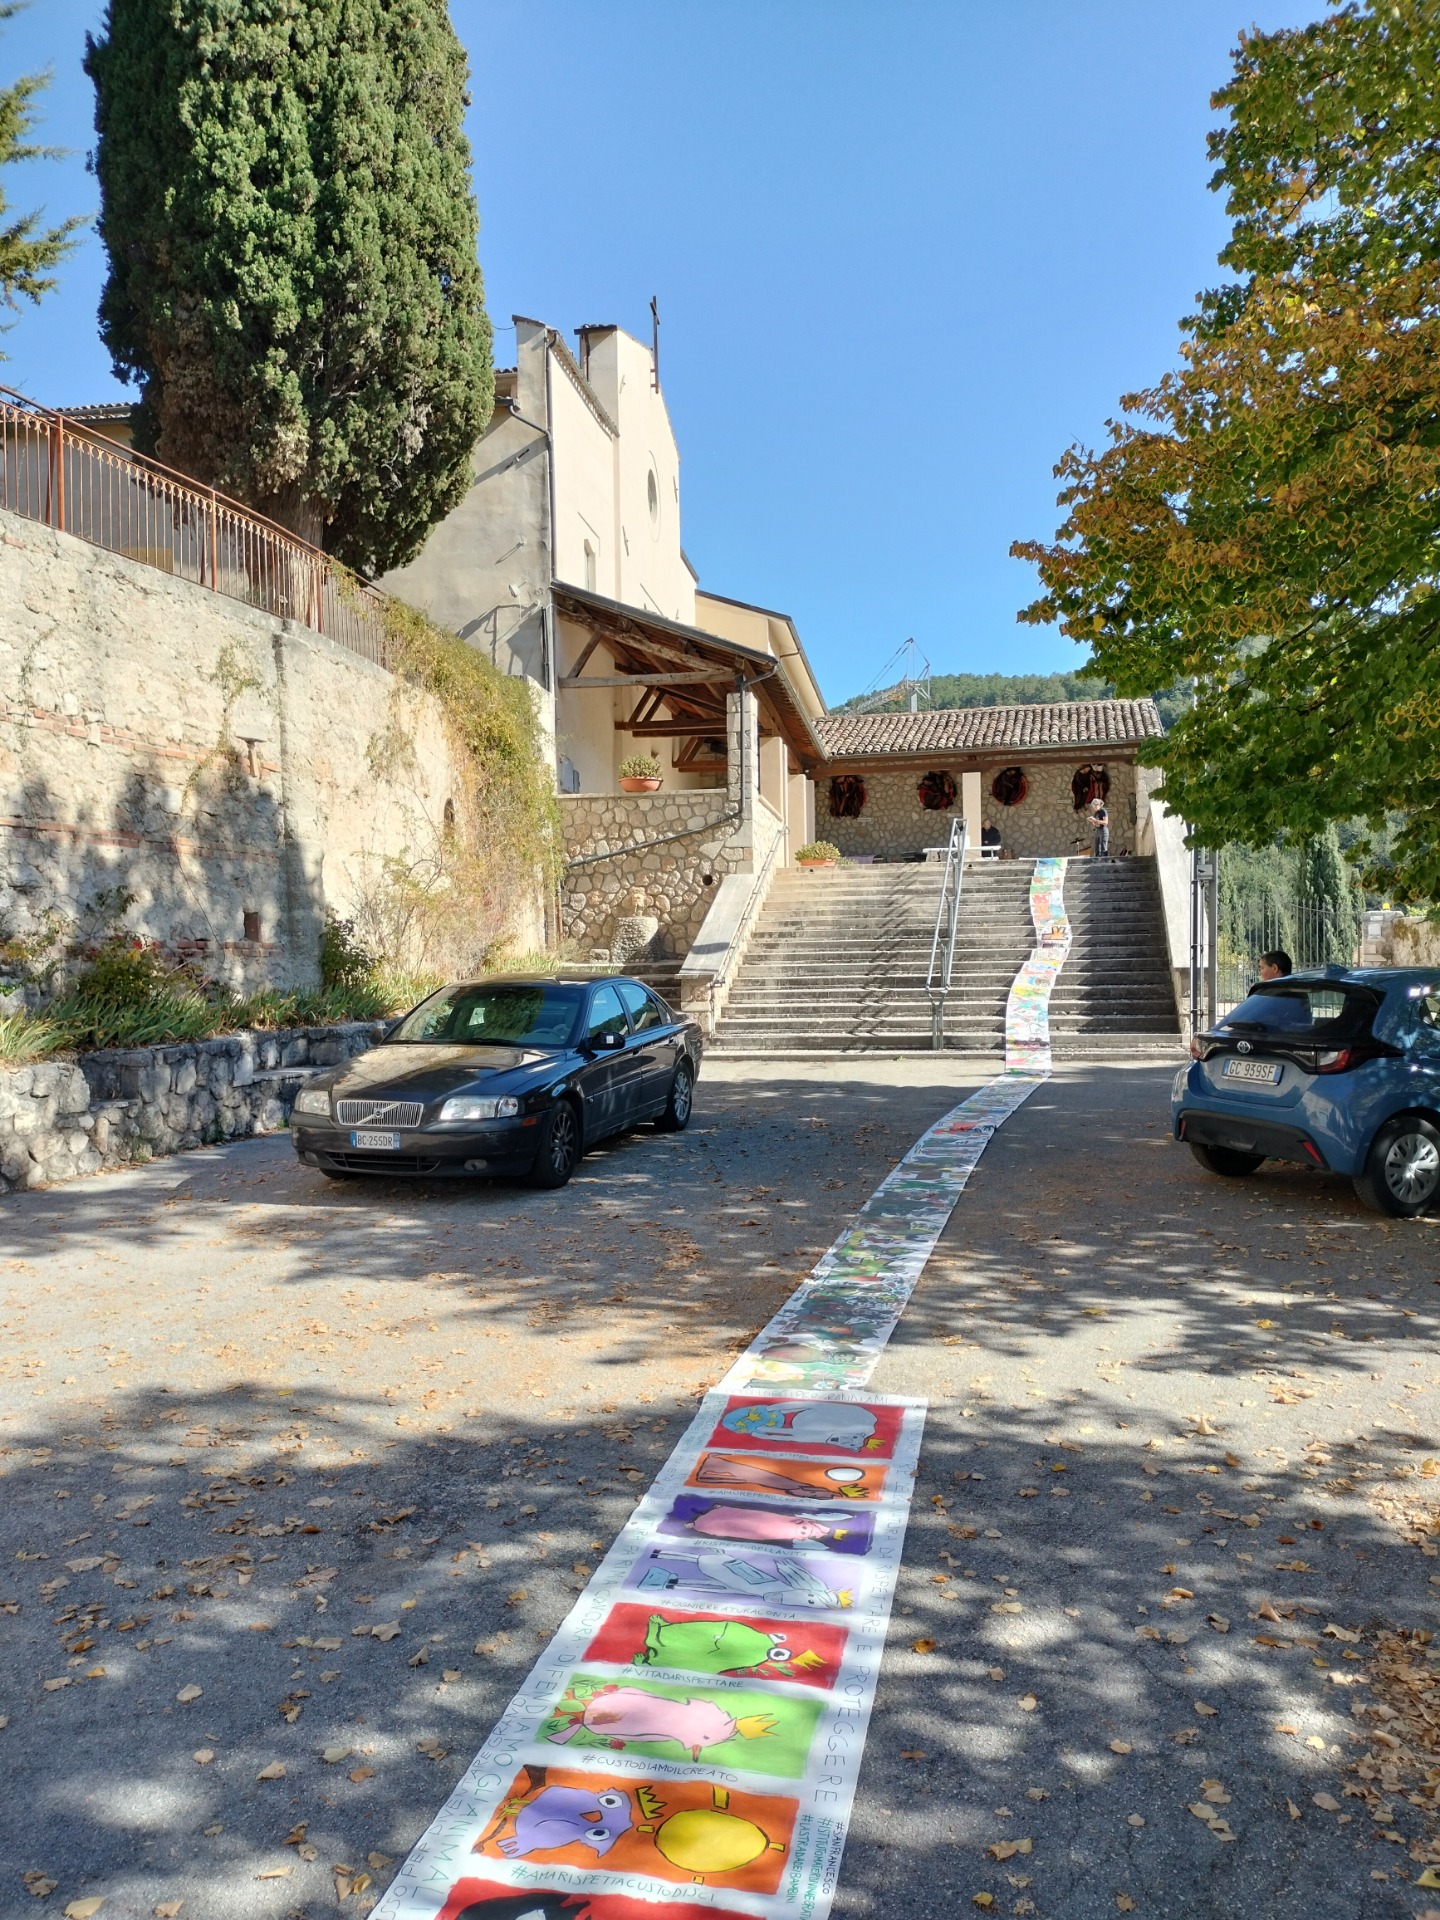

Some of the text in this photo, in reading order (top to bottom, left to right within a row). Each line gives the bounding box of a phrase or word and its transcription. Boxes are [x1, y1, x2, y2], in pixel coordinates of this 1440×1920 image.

[1229, 1061, 1275, 1079] GC 939SF
[357, 1134, 392, 1147] BC 255DR
[861, 1564, 894, 1634] RISPETTARE
[621, 1666, 745, 1688] #VITADARISPETTARE
[856, 1643, 873, 1653] E
[493, 1653, 577, 1767] DIFENDIAMO
[814, 1665, 871, 1803] PROTEGGERE
[582, 1753, 739, 1783] #CUSTODIAMOILCREATO
[376, 1886, 408, 1920] SSO
[400, 1842, 428, 1879] PER
[429, 1751, 492, 1836] DIVENTARE
[409, 1802, 479, 1911] ANIMALI
[786, 1813, 814, 1904] #LASTRADADEIBAMBINI
[822, 1821, 845, 1895] #SANFRANCESCO
[510, 1864, 715, 1902] #AMARISPETTACUSTODISCI
